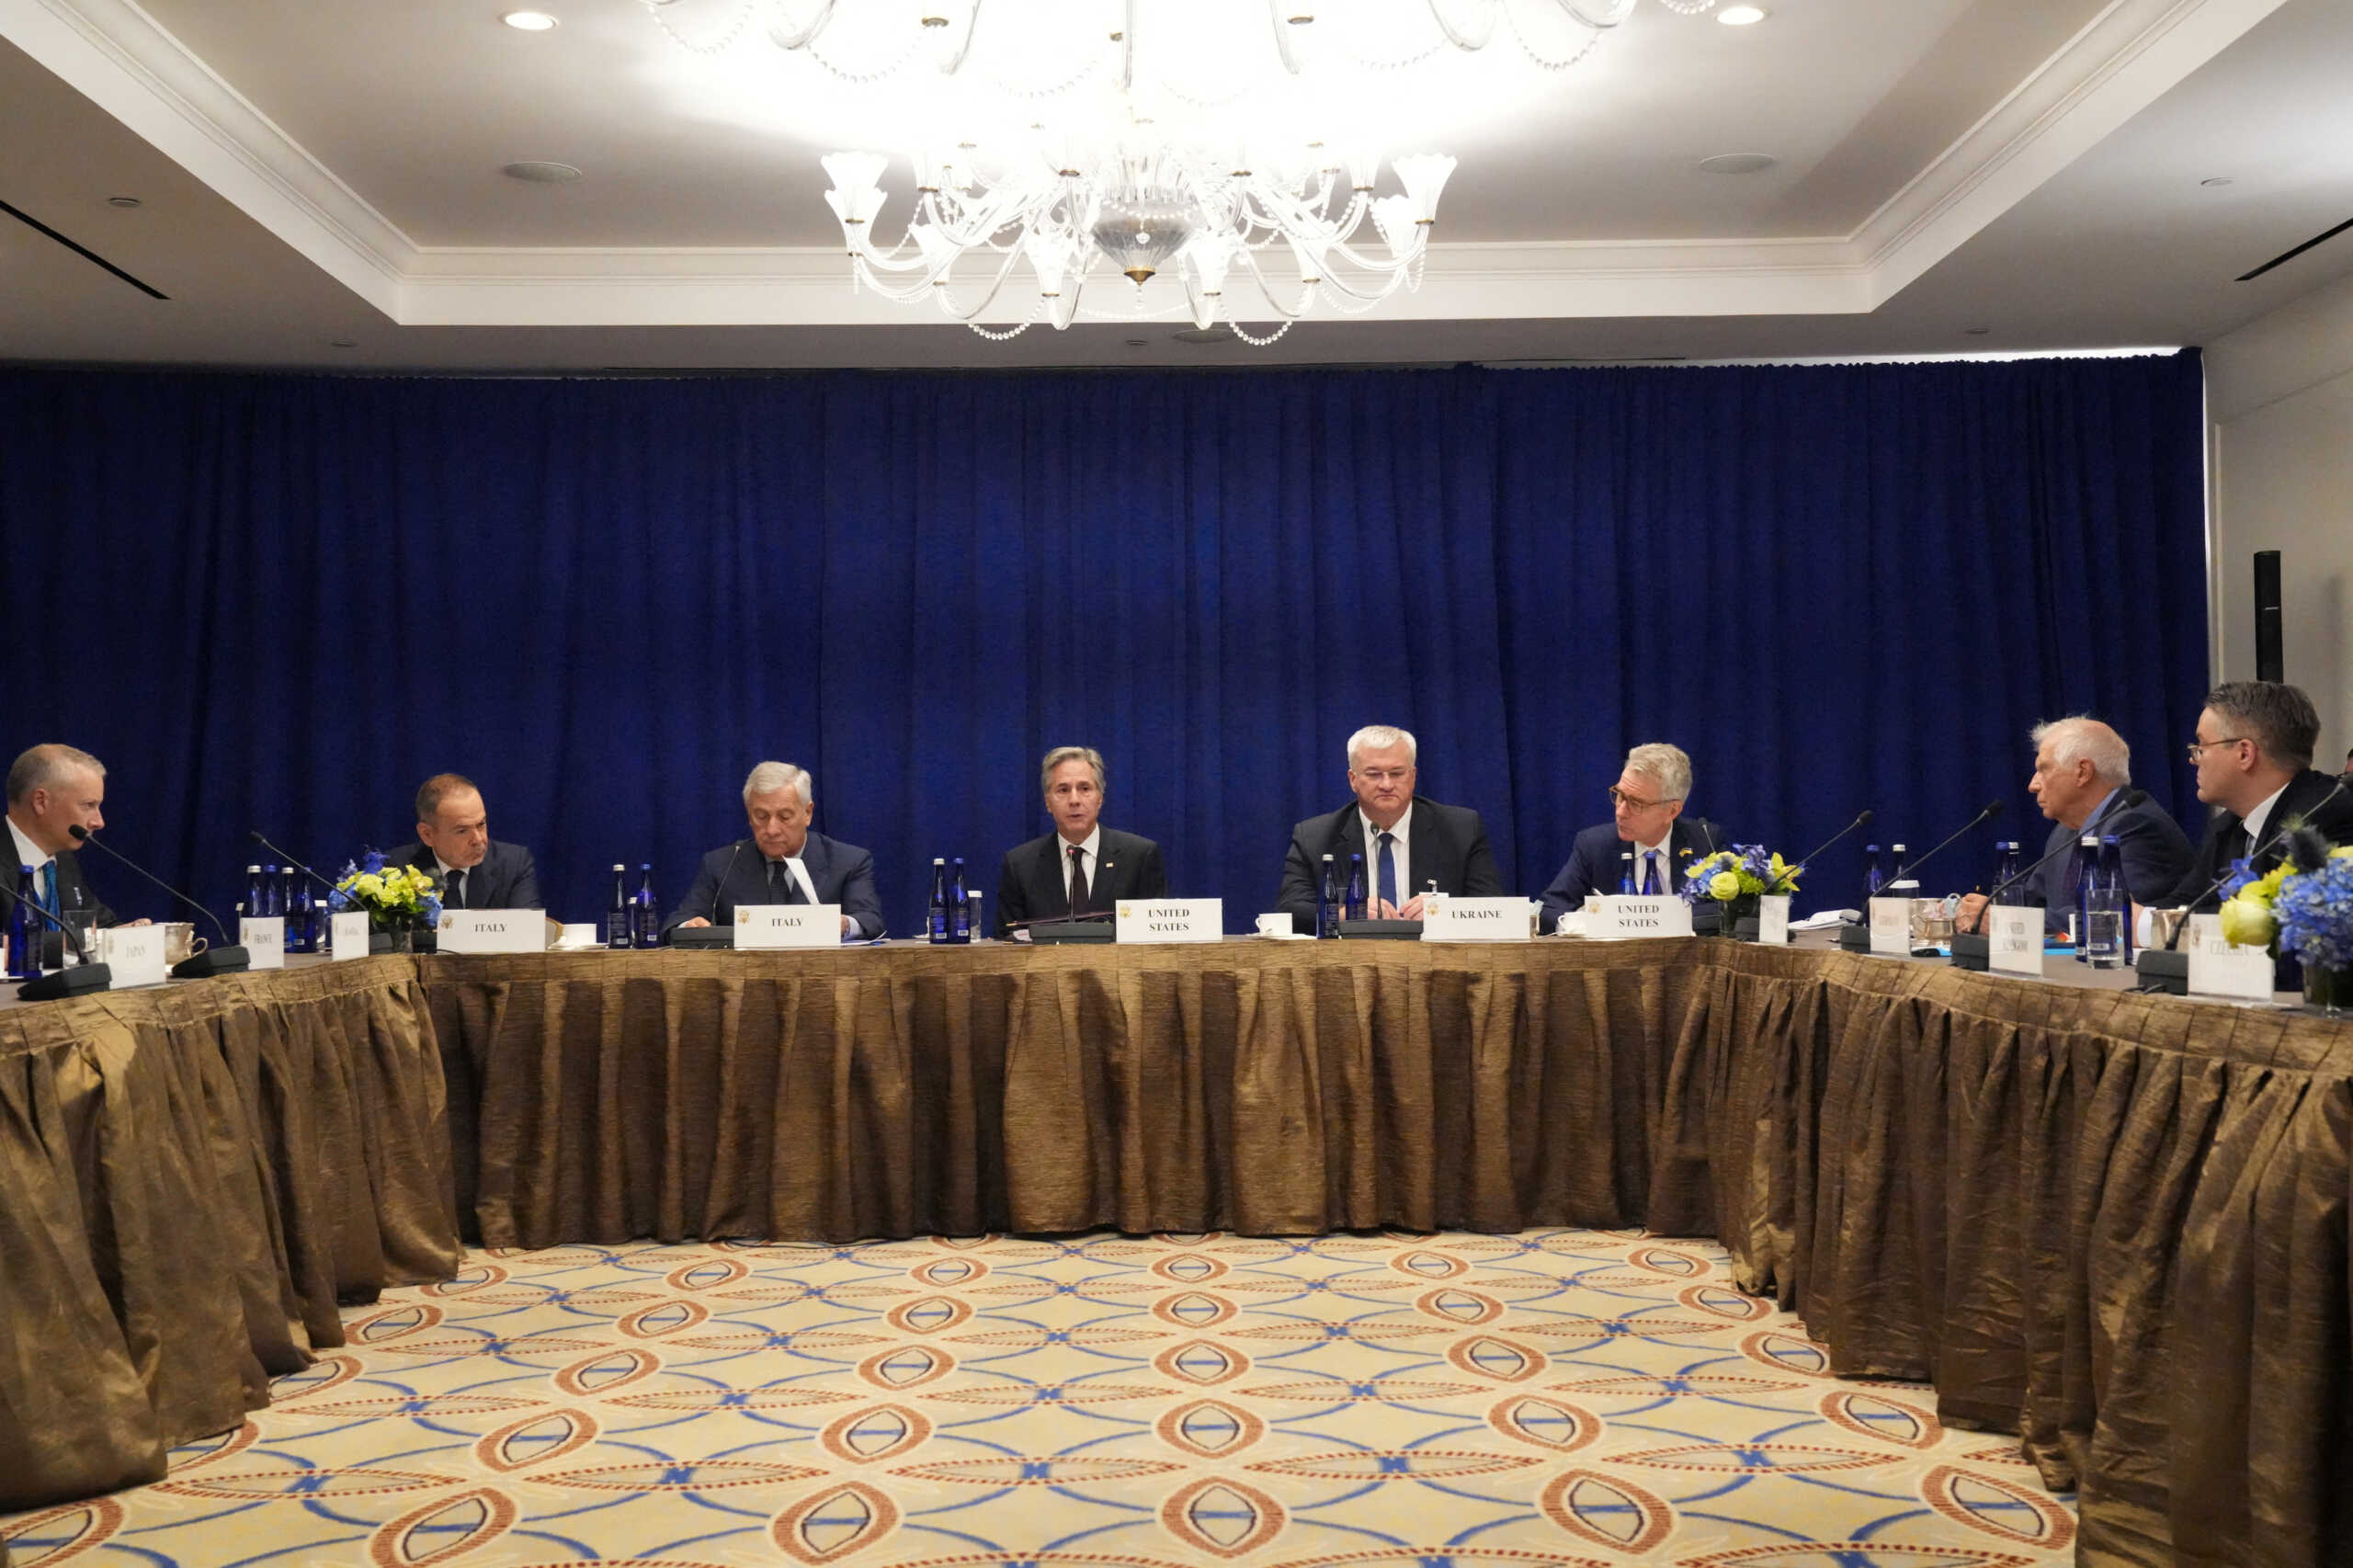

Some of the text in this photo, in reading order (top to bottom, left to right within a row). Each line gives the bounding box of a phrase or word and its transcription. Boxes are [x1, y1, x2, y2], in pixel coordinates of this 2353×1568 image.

[1148, 908, 1190, 917] UNITED
[1618, 904, 1659, 914] UNITED
[1451, 910, 1503, 919] UKRAINE
[771, 918, 803, 927] ITALY
[1619, 919, 1659, 927] STATES
[474, 923, 507, 932] ITALY
[1149, 923, 1189, 932] STATES
